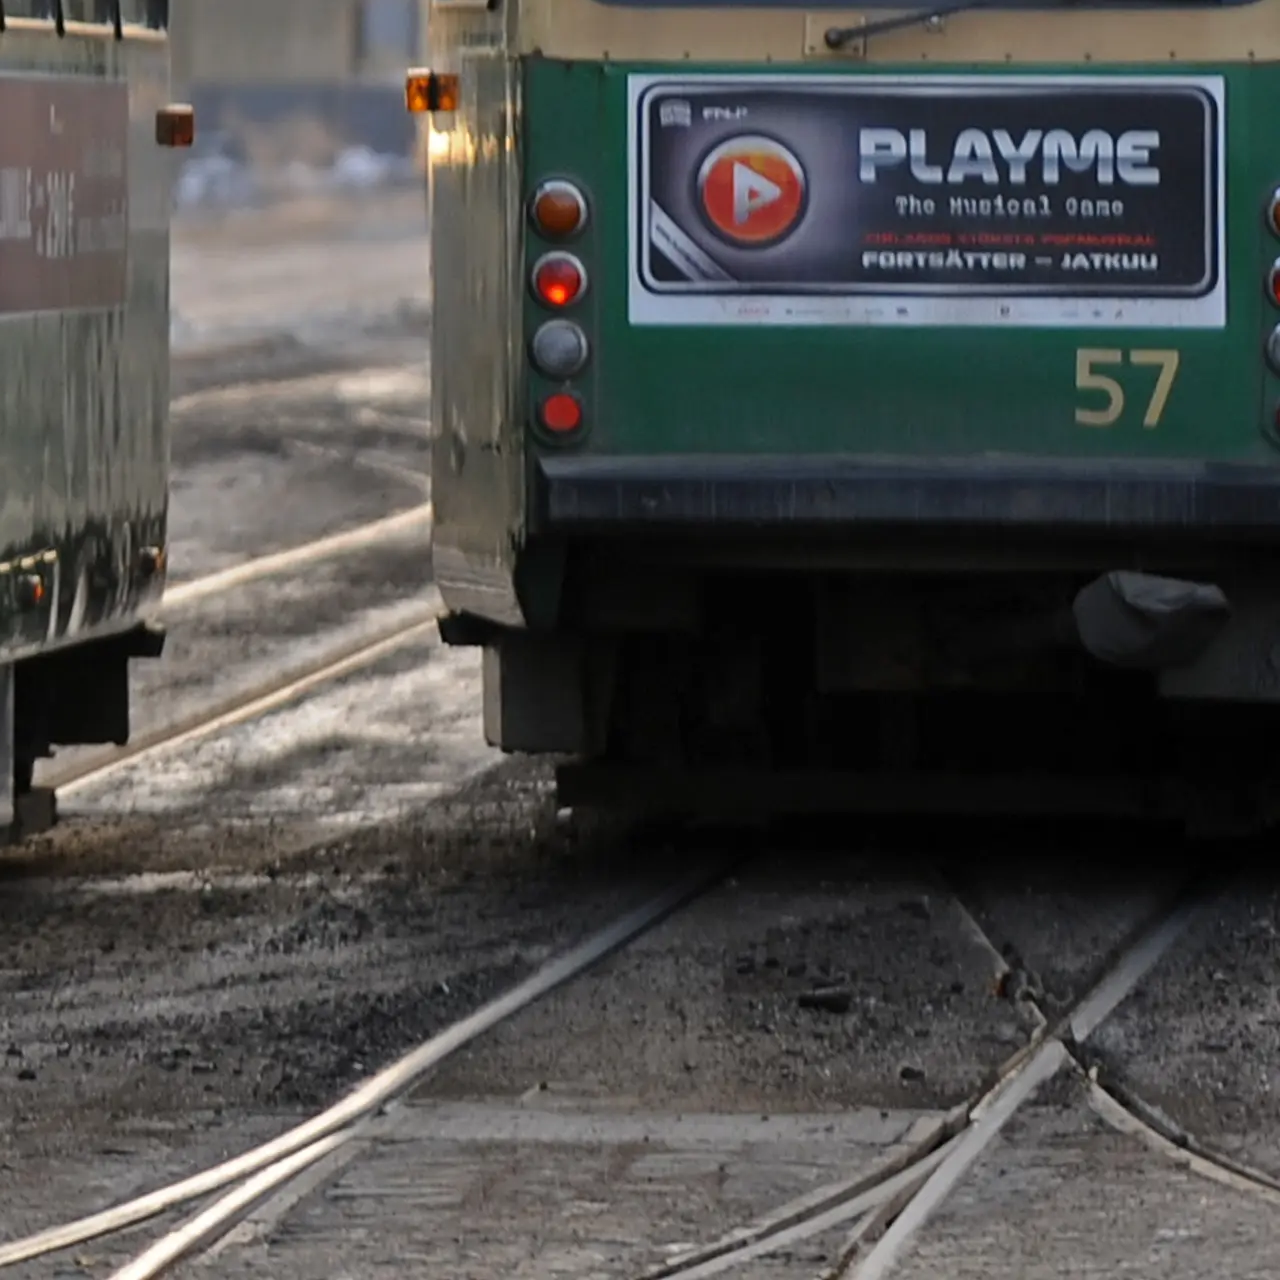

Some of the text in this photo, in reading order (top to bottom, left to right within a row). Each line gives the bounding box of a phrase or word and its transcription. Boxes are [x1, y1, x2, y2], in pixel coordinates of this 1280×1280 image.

[859, 128, 1161, 185] PLAYME
[895, 193, 1124, 217] The Musical Game
[862, 248, 1027, 270] FORTSÄTTER
[1060, 252, 1159, 271] JATKUU
[1074, 348, 1180, 428] 57
